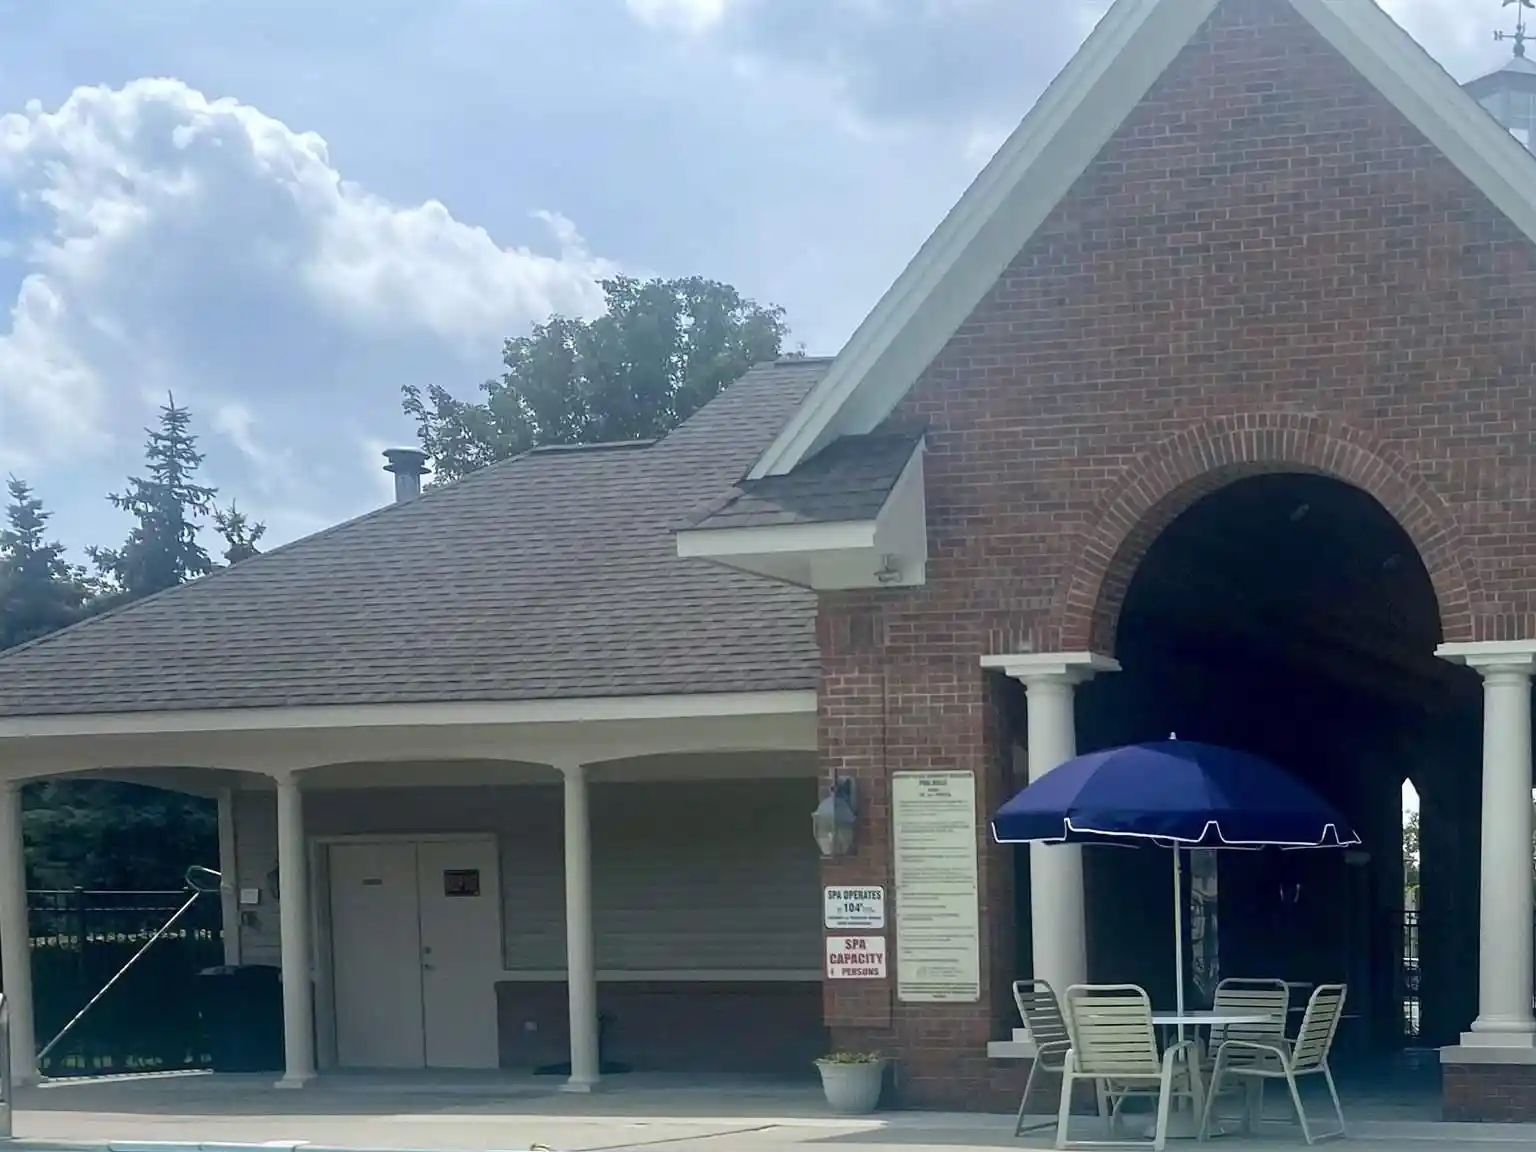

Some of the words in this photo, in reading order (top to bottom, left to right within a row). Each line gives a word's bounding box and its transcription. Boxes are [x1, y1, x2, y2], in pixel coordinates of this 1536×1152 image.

[828, 890, 842, 900] SPA
[843, 890, 881, 900] OPERATES
[844, 938, 866, 949] SPA
[829, 953, 883, 964] CAPACITY
[842, 967, 879, 976] PERSONS
